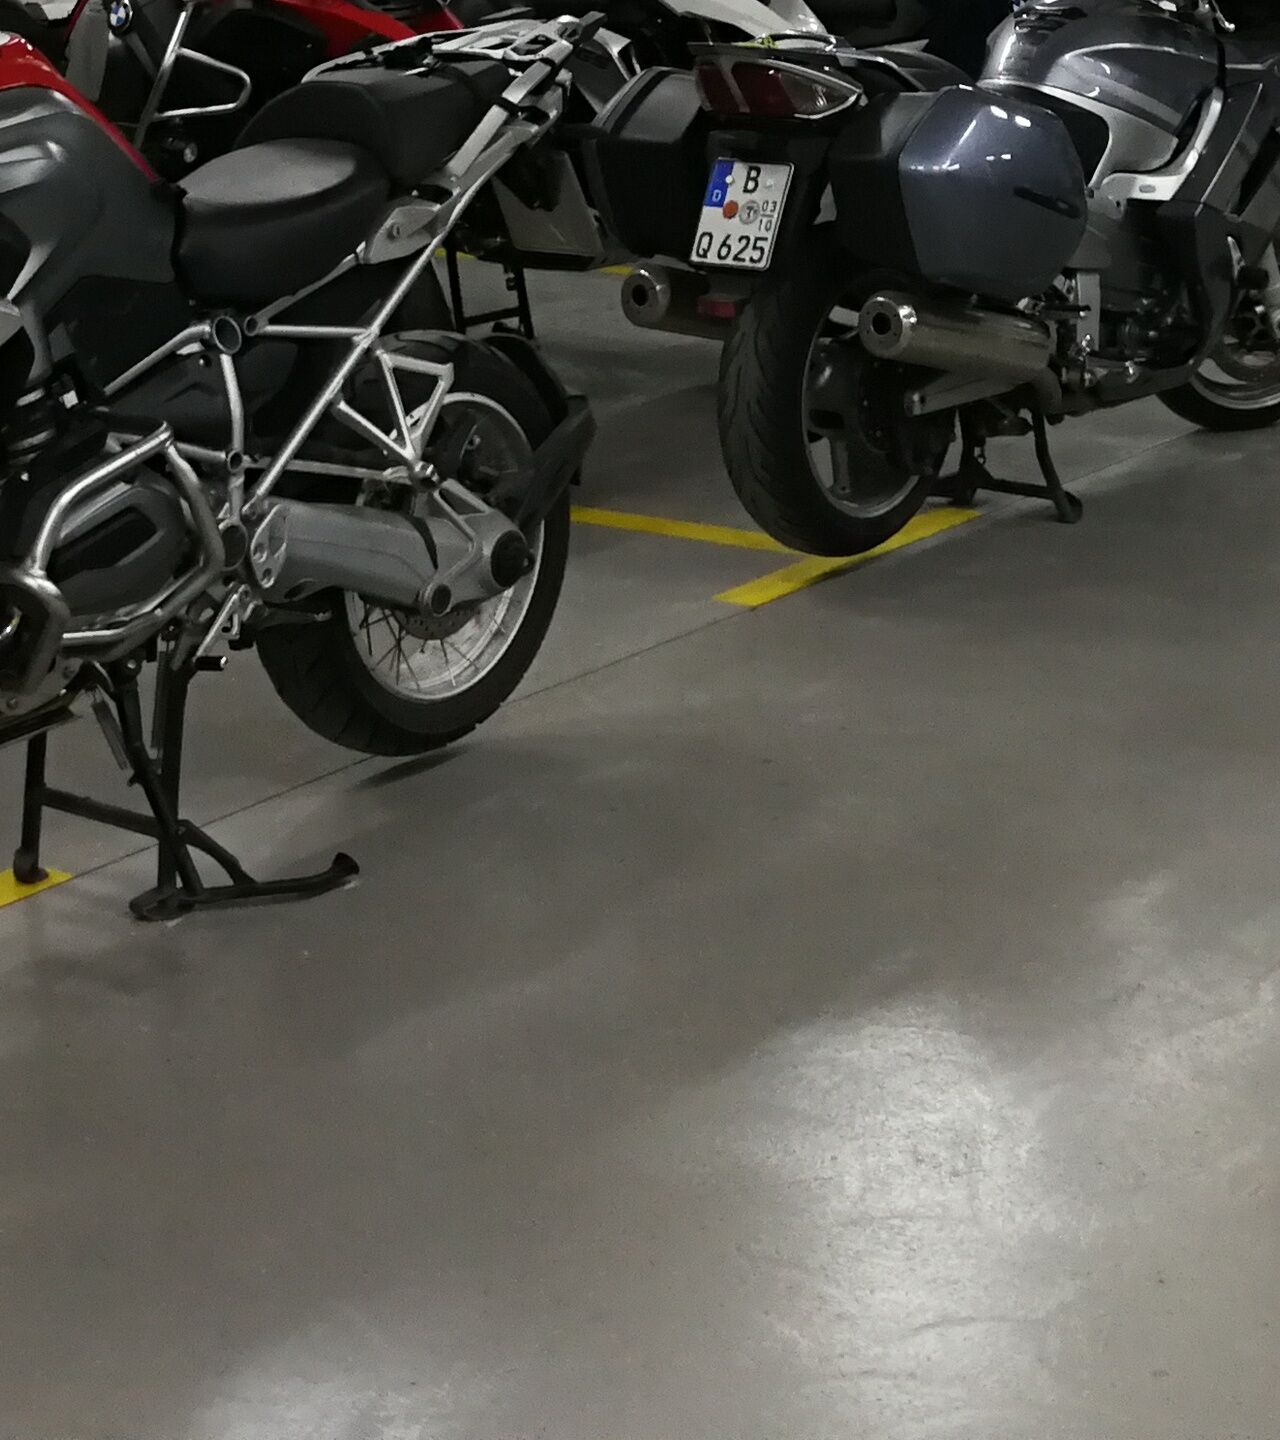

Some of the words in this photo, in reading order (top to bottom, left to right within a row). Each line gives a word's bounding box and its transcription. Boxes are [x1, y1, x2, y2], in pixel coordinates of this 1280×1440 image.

[742, 165, 762, 193] B
[761, 200, 778, 213] 03
[758, 218, 773, 232] 10
[696, 231, 714, 259] Q
[717, 234, 769, 264] 625
